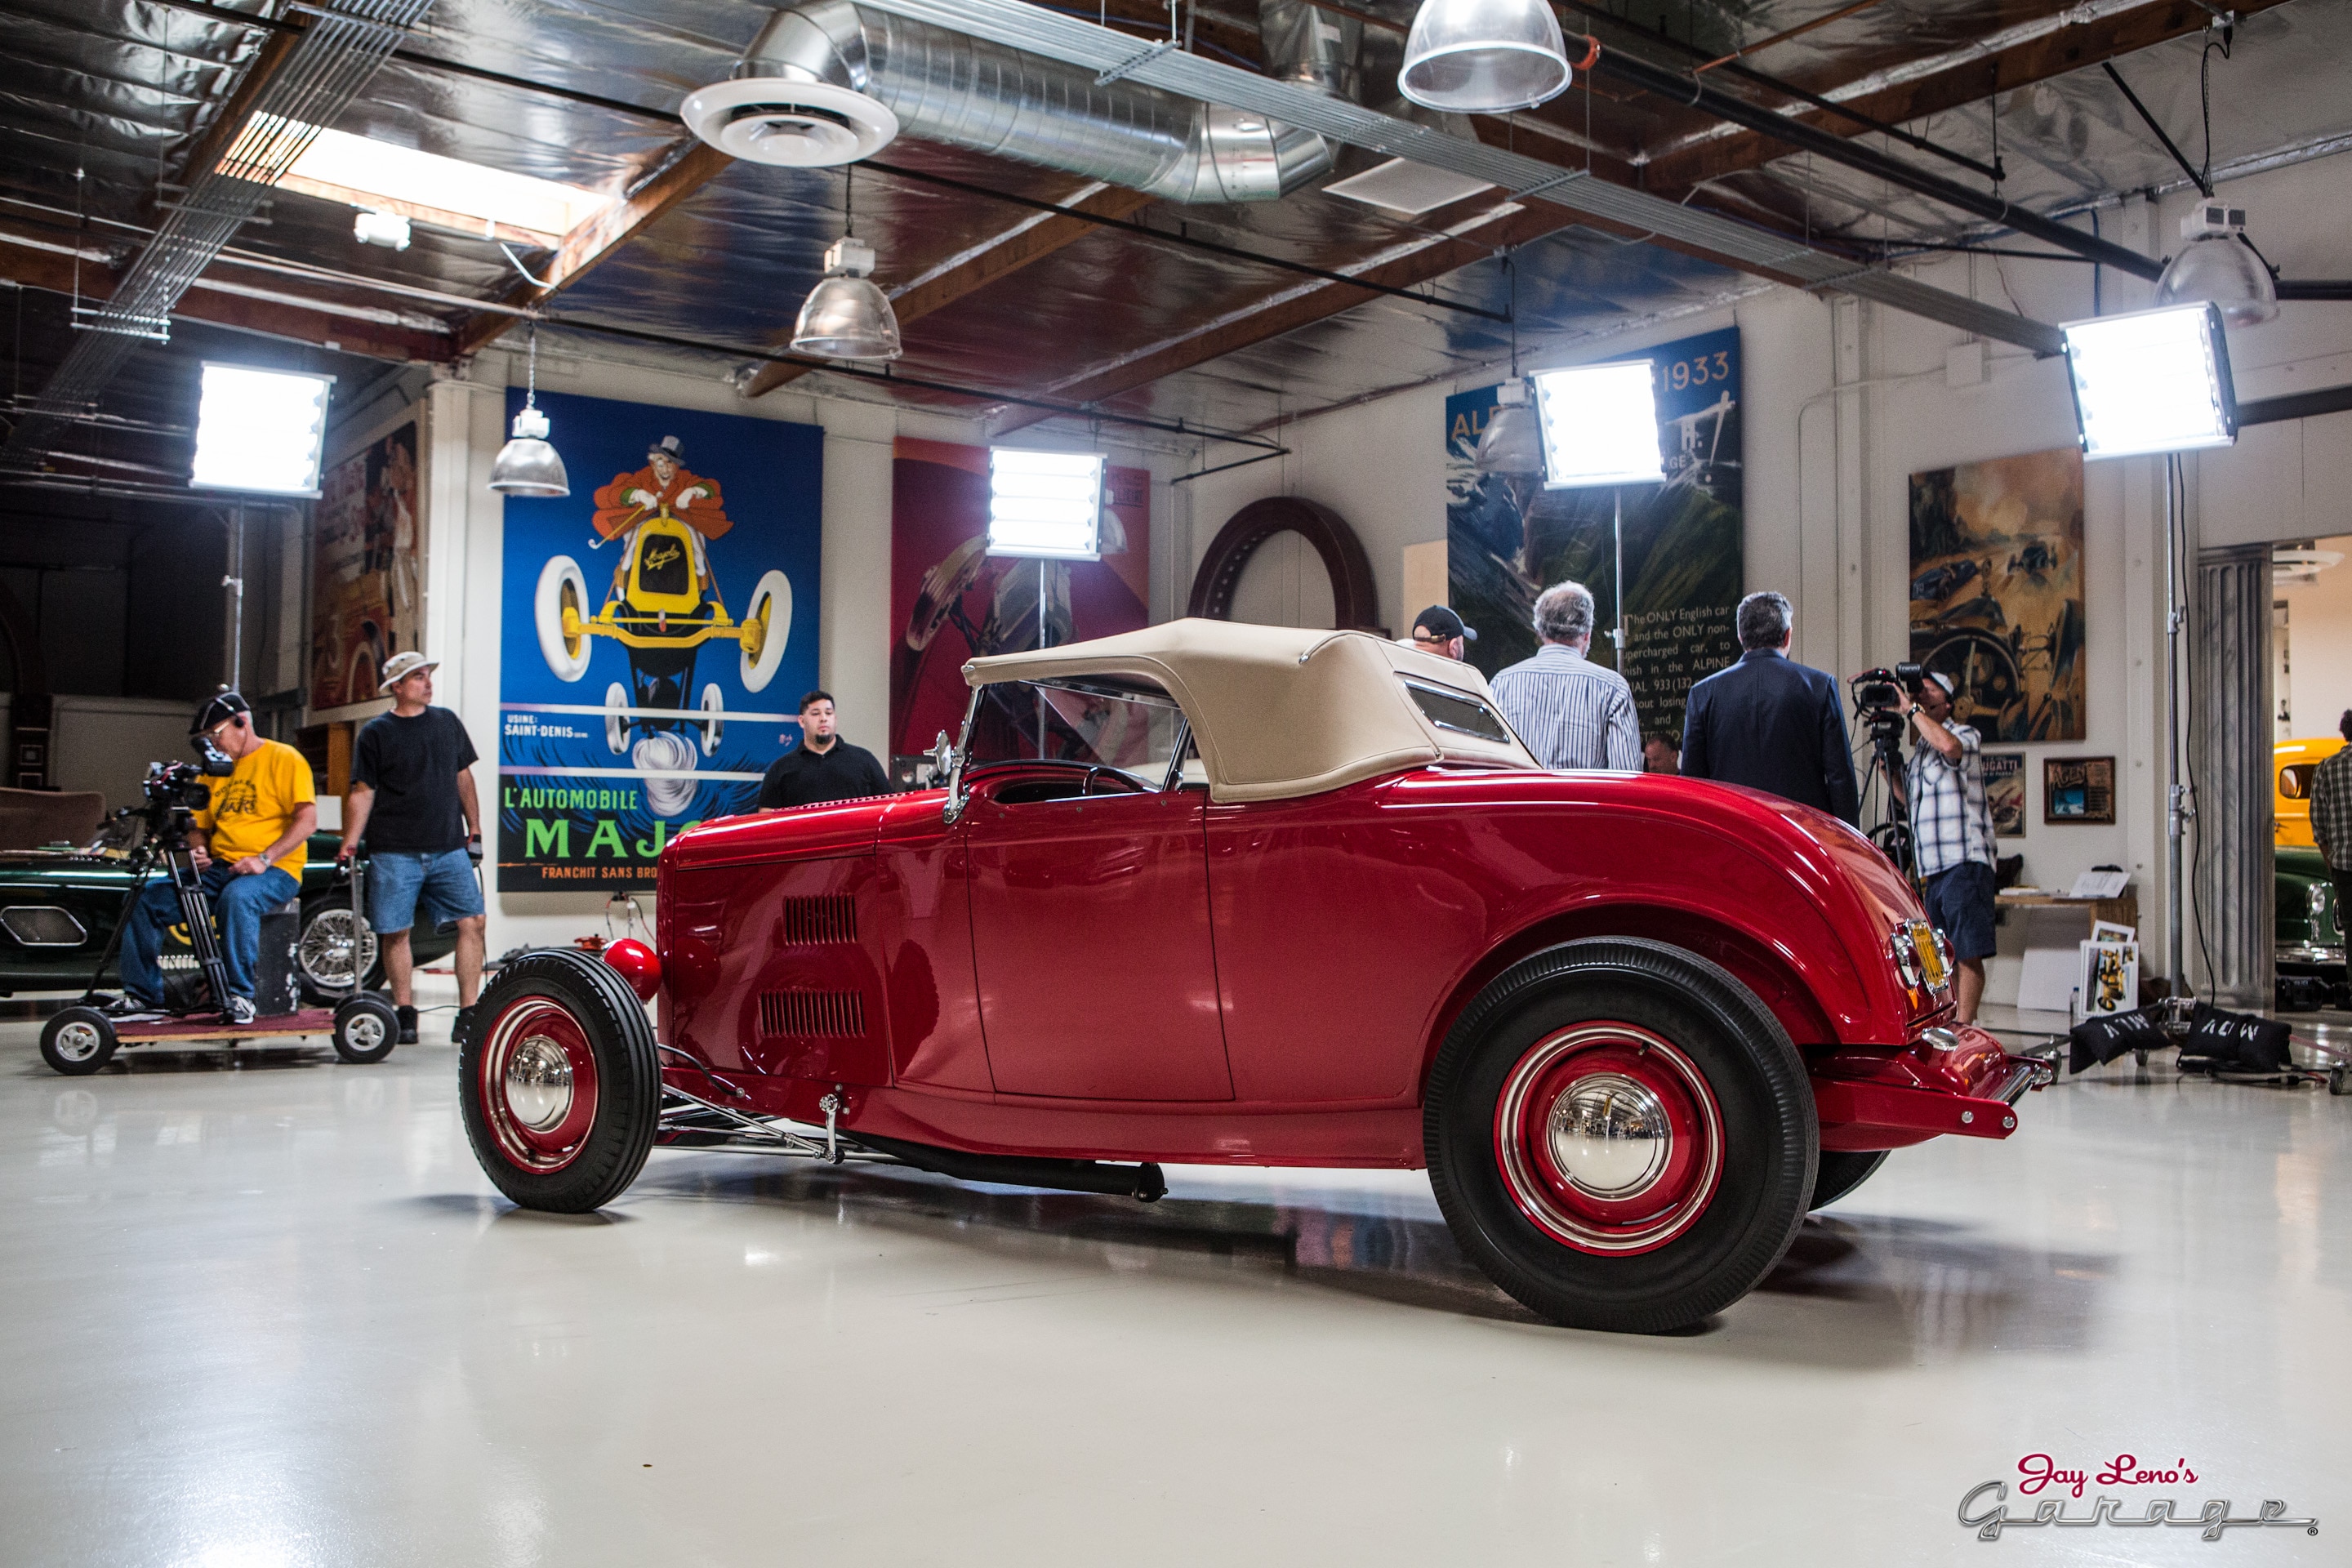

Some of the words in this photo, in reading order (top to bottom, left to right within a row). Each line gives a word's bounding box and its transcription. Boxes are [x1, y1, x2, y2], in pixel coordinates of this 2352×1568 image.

[1662, 351, 1730, 393] 1933
[1623, 613, 1646, 636] The
[1646, 609, 1677, 623] ONLY
[1679, 605, 1713, 621] English
[1715, 606, 1730, 616] car
[1634, 630, 1650, 642] and
[1654, 629, 1668, 639] the
[1673, 624, 1704, 638] ONLY
[1708, 624, 1730, 635] non-
[1720, 642, 1731, 651] to
[1651, 663, 1659, 674] in
[1668, 662, 1683, 672] the
[1693, 656, 1731, 671] ALPINE
[1655, 713, 1671, 726] and
[1982, 760, 2018, 772] UGATTI
[504, 787, 638, 810] L'AUTOMOBILE
[541, 866, 596, 880] FRANCHIT
[601, 866, 633, 880] SANS
[636, 866, 657, 879] BRO
